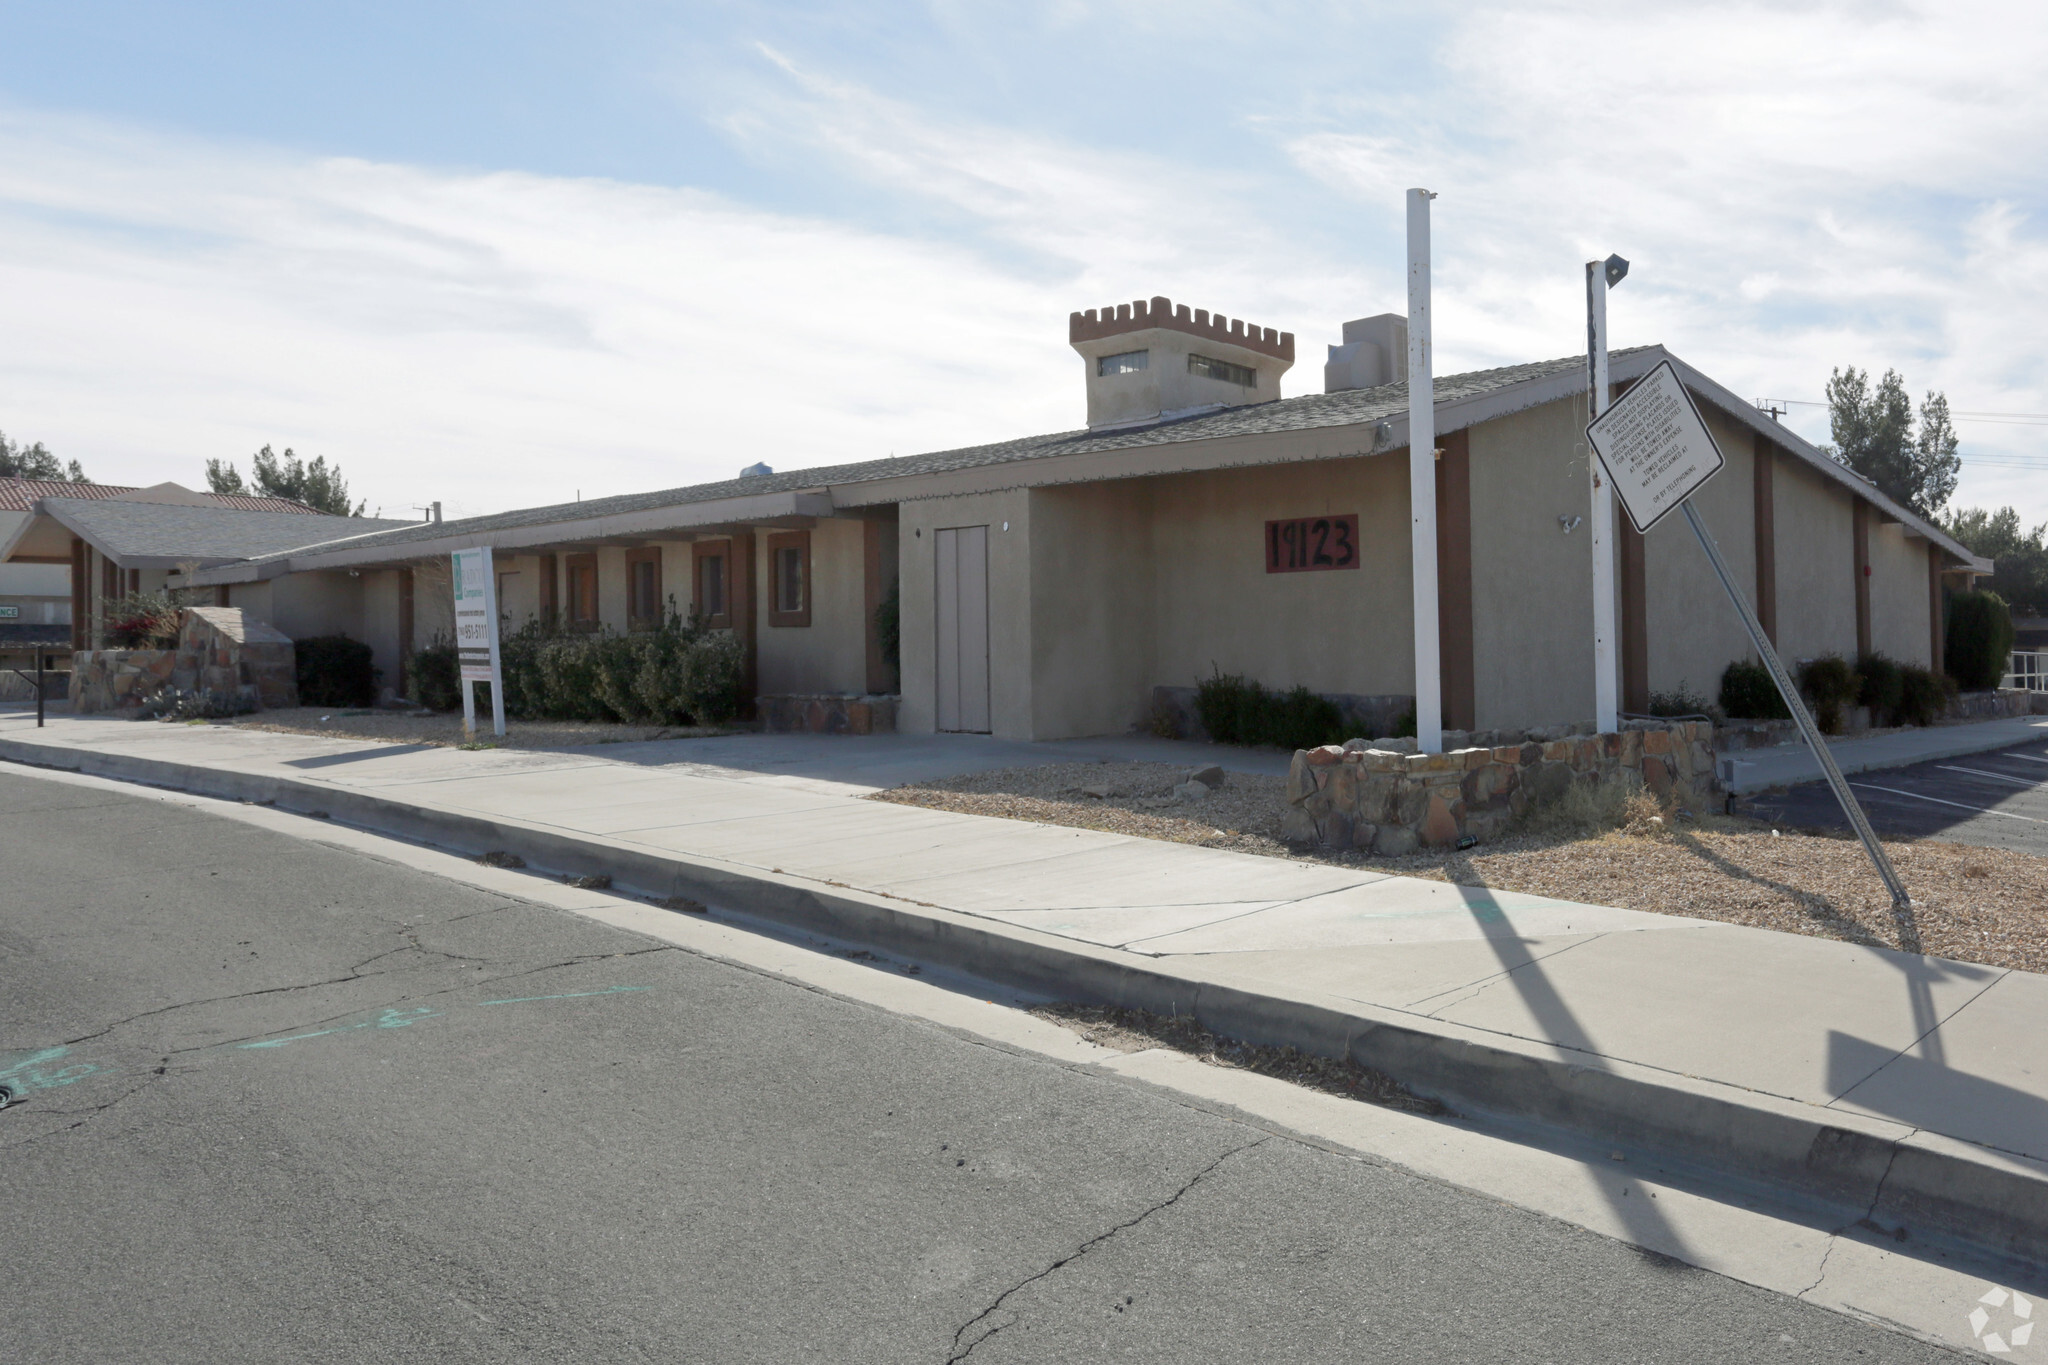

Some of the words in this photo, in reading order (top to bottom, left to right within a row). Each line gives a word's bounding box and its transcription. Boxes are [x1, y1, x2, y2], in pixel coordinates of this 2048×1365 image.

[1596, 404, 1627, 434] UNAUTHORIZED
[1627, 386, 1647, 406] VEHICLES
[1647, 371, 1664, 389] PARKED
[1610, 419, 1643, 451] DISTINGUISHING
[1643, 401, 1664, 422] PLACARDS
[1611, 407, 1636, 431] DESIGNATED
[1636, 384, 1662, 408] ACCESSIBLE
[1612, 423, 1629, 439] SPACES
[1629, 415, 1637, 425] NOT
[1637, 393, 1663, 418] DISPLAYING
[1611, 442, 1629, 460] SPECIAL
[1630, 428, 1647, 444] LICENSE
[1646, 414, 1662, 429] PLATES
[1662, 400, 1678, 415] ISSUED
[1616, 456, 1625, 466] FOR
[1625, 441, 1644, 458] PERSONS
[1644, 430, 1655, 441] WITH
[1655, 407, 1682, 432] DISABILITIES
[1629, 466, 1635, 474] AT
[1635, 458, 1644, 468] THE
[1644, 442, 1663, 461] OWNER'S
[1663, 425, 1683, 445] EXPENSE
[1631, 452, 1641, 463] WILL
[1647, 434, 1661, 448] TOWED
[1662, 424, 1674, 438] AWAY
[1642, 478, 1651, 488] MAY
[1659, 451, 1682, 473] RECLAIMED
[1682, 446, 1689, 454] AT
[1643, 461, 1659, 476] TOWED
[1658, 444, 1679, 464] VEHICLES
[1653, 495, 1660, 503] OR
[1659, 490, 1667, 498] BY
[1666, 465, 1696, 491] TELEPHONING
[1272, 519, 1353, 568] 19123
[465, 624, 487, 639] 951-5111
